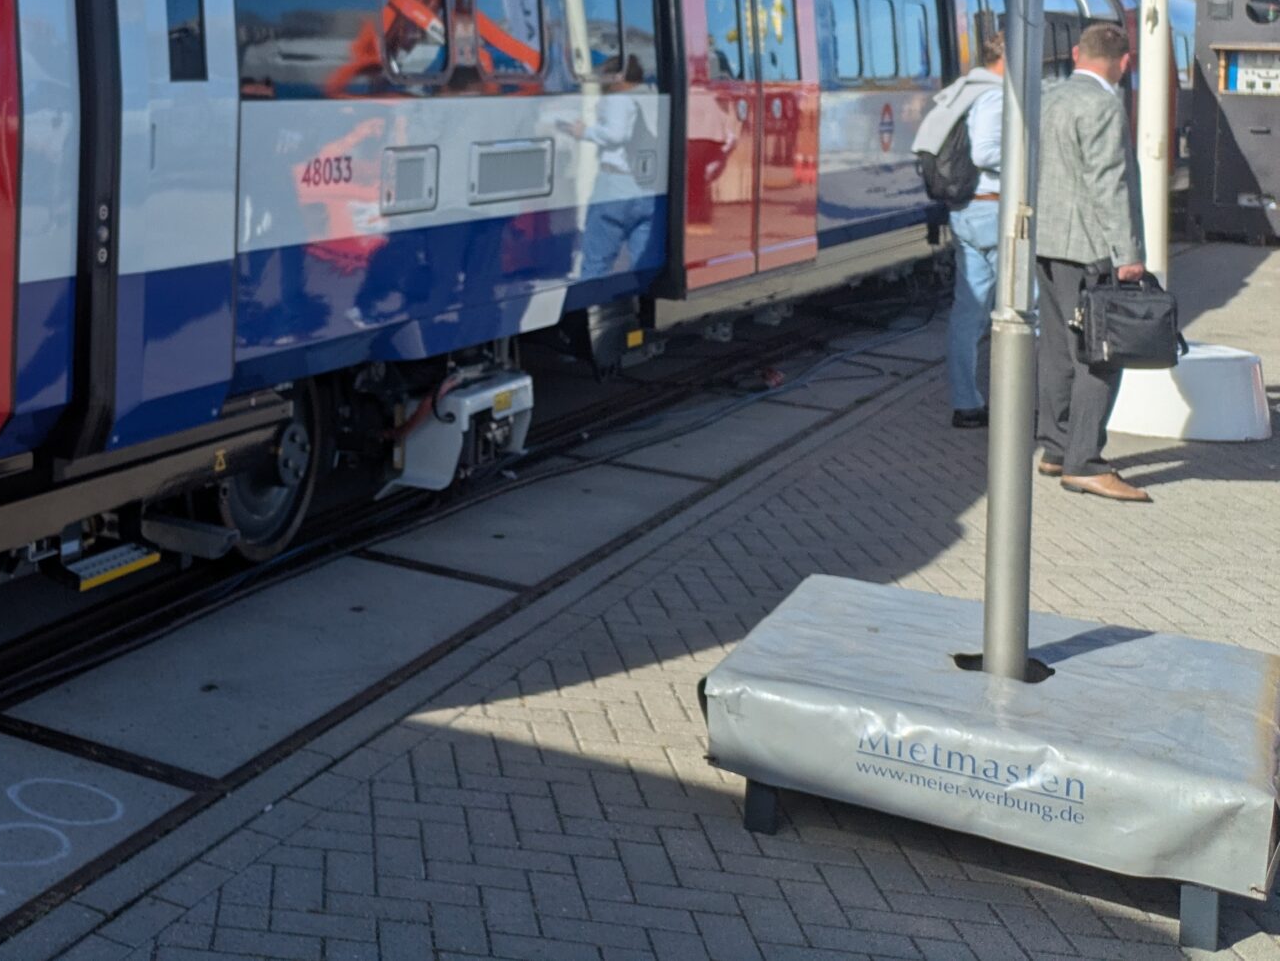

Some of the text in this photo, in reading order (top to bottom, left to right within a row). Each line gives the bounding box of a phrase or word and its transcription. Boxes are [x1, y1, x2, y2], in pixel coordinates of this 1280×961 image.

[301, 155, 353, 187] 48033
[856, 761, 1086, 825] www.meier-werbung.de
[858, 727, 1086, 800] Mietmasten
